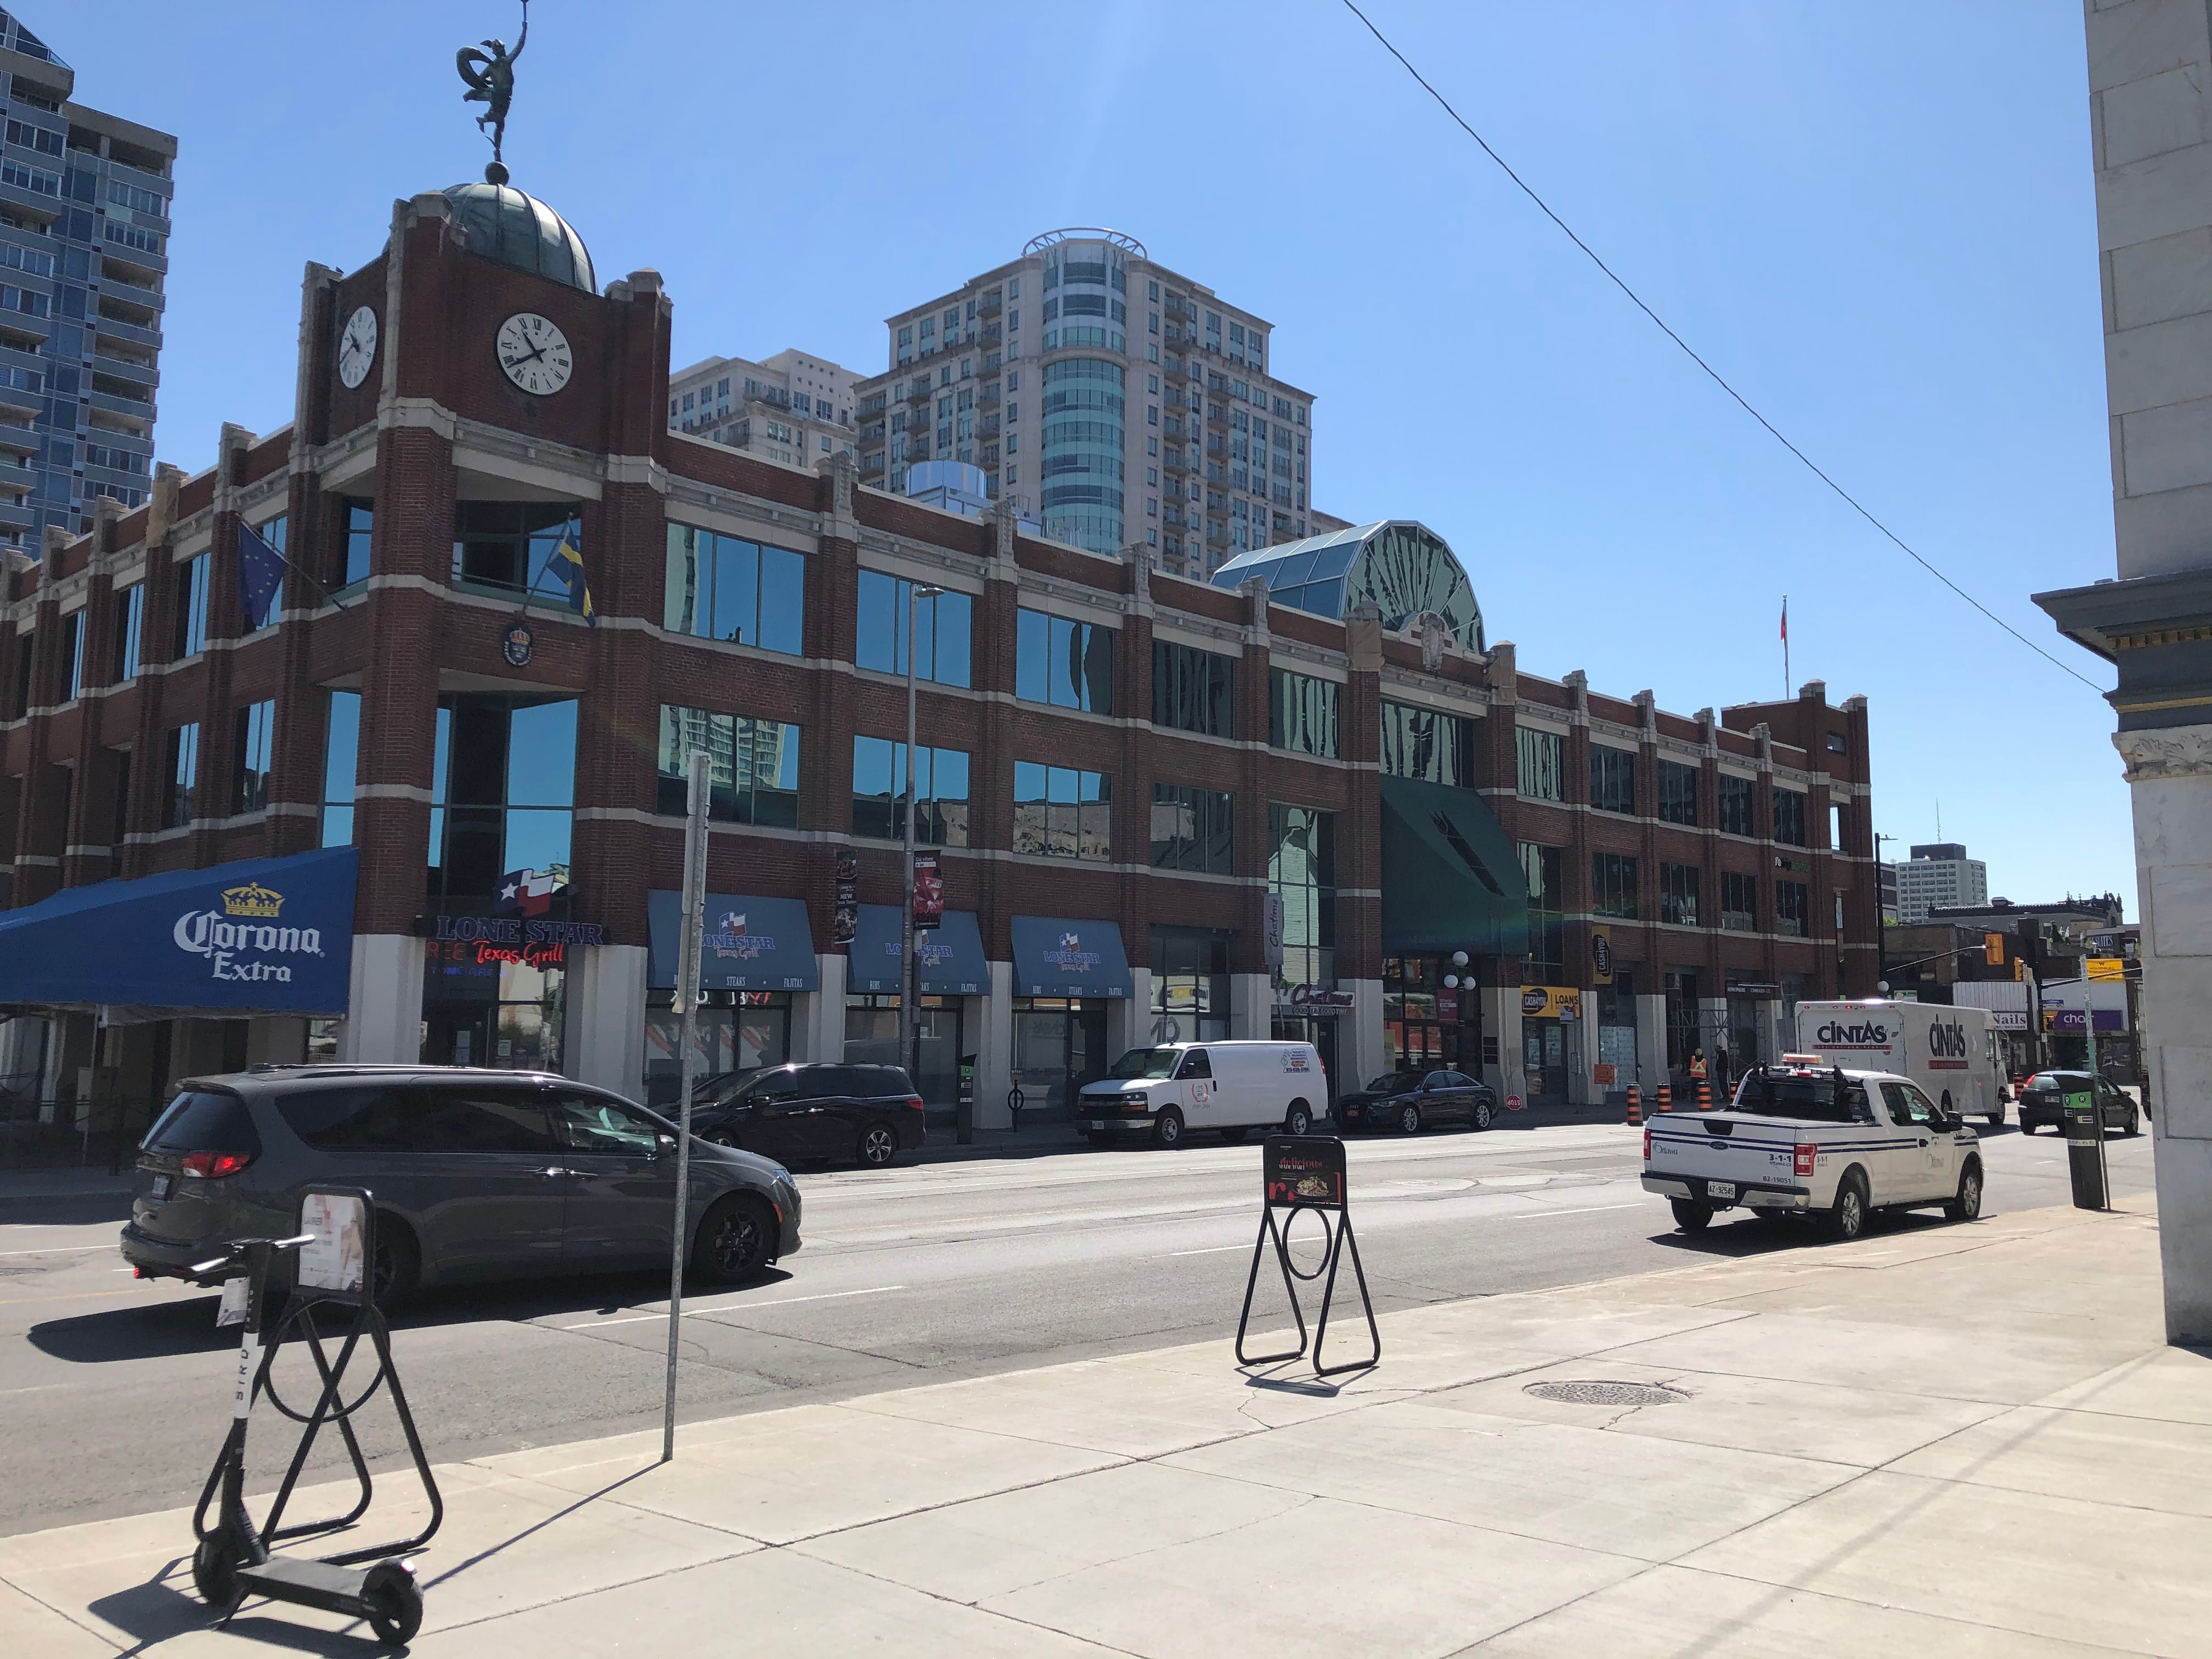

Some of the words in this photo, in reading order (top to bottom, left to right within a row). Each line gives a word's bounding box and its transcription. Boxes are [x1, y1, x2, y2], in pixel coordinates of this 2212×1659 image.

[1269, 899, 1279, 947] Chatime
[173, 910, 321, 958] Corona
[437, 916, 520, 943] LONE
[525, 919, 603, 946] STAR
[702, 934, 735, 948] ONE
[736, 936, 776, 950] STAR
[472, 940, 520, 964] Texas
[523, 940, 564, 968] Grill
[922, 945, 953, 957] STAR
[1043, 951, 1073, 963] LONE
[1073, 952, 1101, 964] STAR
[1598, 938, 1606, 970] CASH4YOU
[212, 951, 291, 982] Extra
[726, 977, 746, 986] STEAKS
[784, 978, 803, 988] FAJITAS
[870, 980, 880, 990] RIBS
[961, 983, 977, 992] FAJITAS
[1293, 984, 1353, 1006] Chatime
[1525, 996, 1546, 1006] CASH4YOU
[1555, 994, 1578, 1005] LOANS
[1293, 1007, 1308, 1015] GOOD
[1993, 1014, 2026, 1024] Nails
[1653, 1142, 1678, 1155] Ottawa
[1280, 1157, 1323, 1168] delicious
[1769, 1154, 1791, 1162] 3-1-1
[236, 1348, 249, 1401] BIRD
